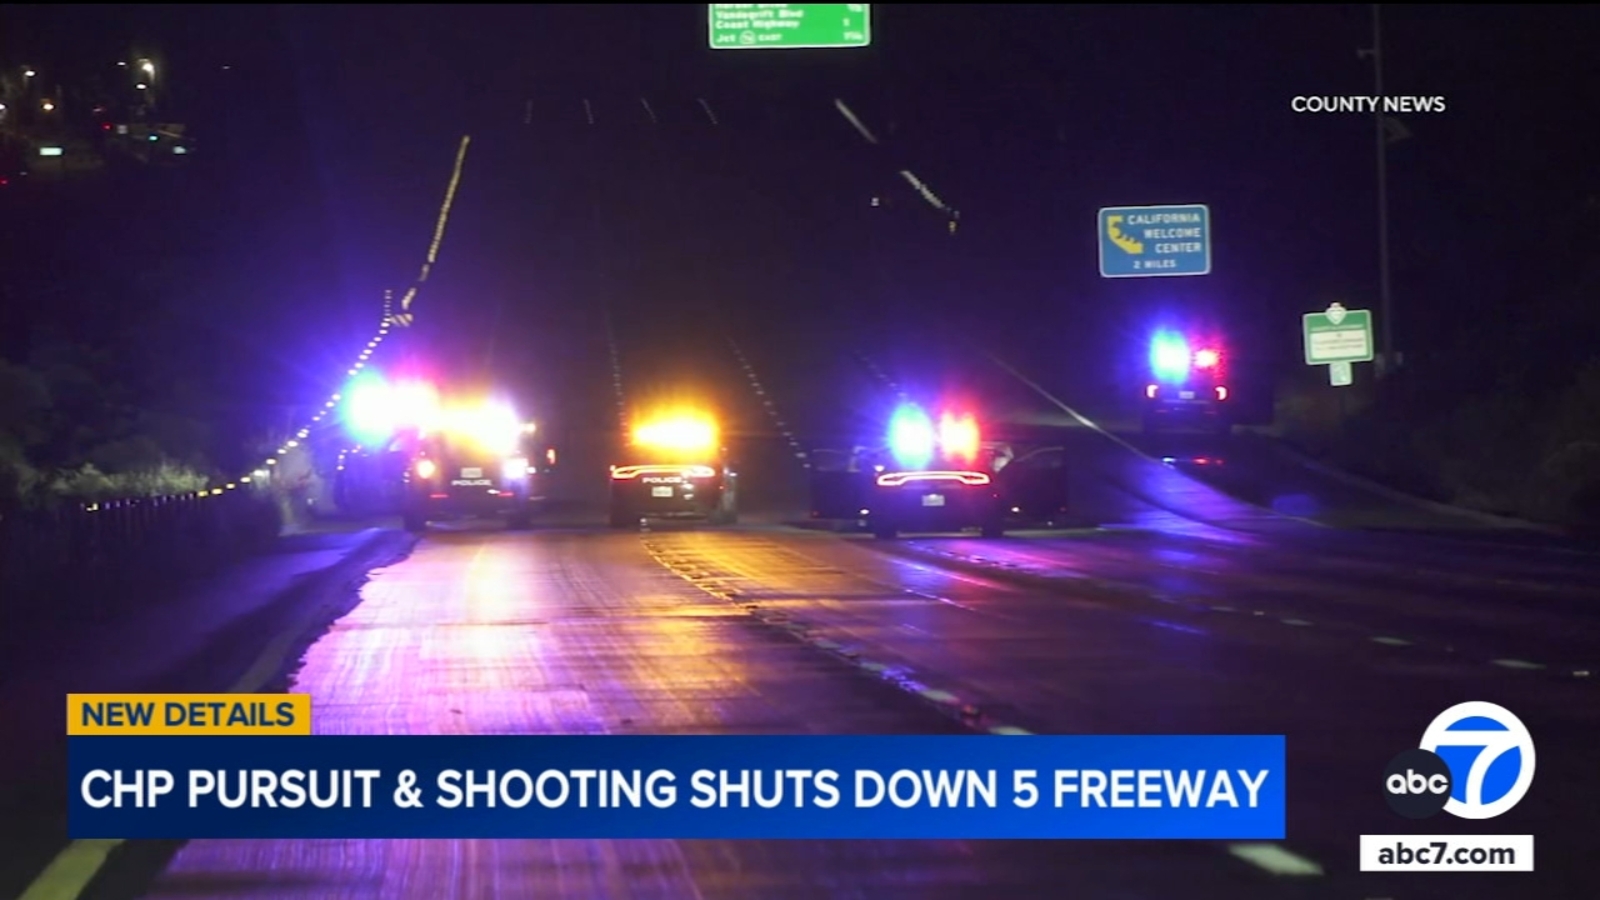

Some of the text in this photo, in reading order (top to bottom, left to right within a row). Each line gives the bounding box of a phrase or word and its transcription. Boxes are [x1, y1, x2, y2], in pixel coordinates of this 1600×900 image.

[752, 20, 800, 30] Highway
[1127, 213, 1200, 225] CALIFORNIA
[1143, 227, 1202, 239] WELCOME
[1155, 242, 1202, 254] CENTER
[1133, 259, 1177, 269] 2 MILES
[642, 476, 682, 484] POLICE
